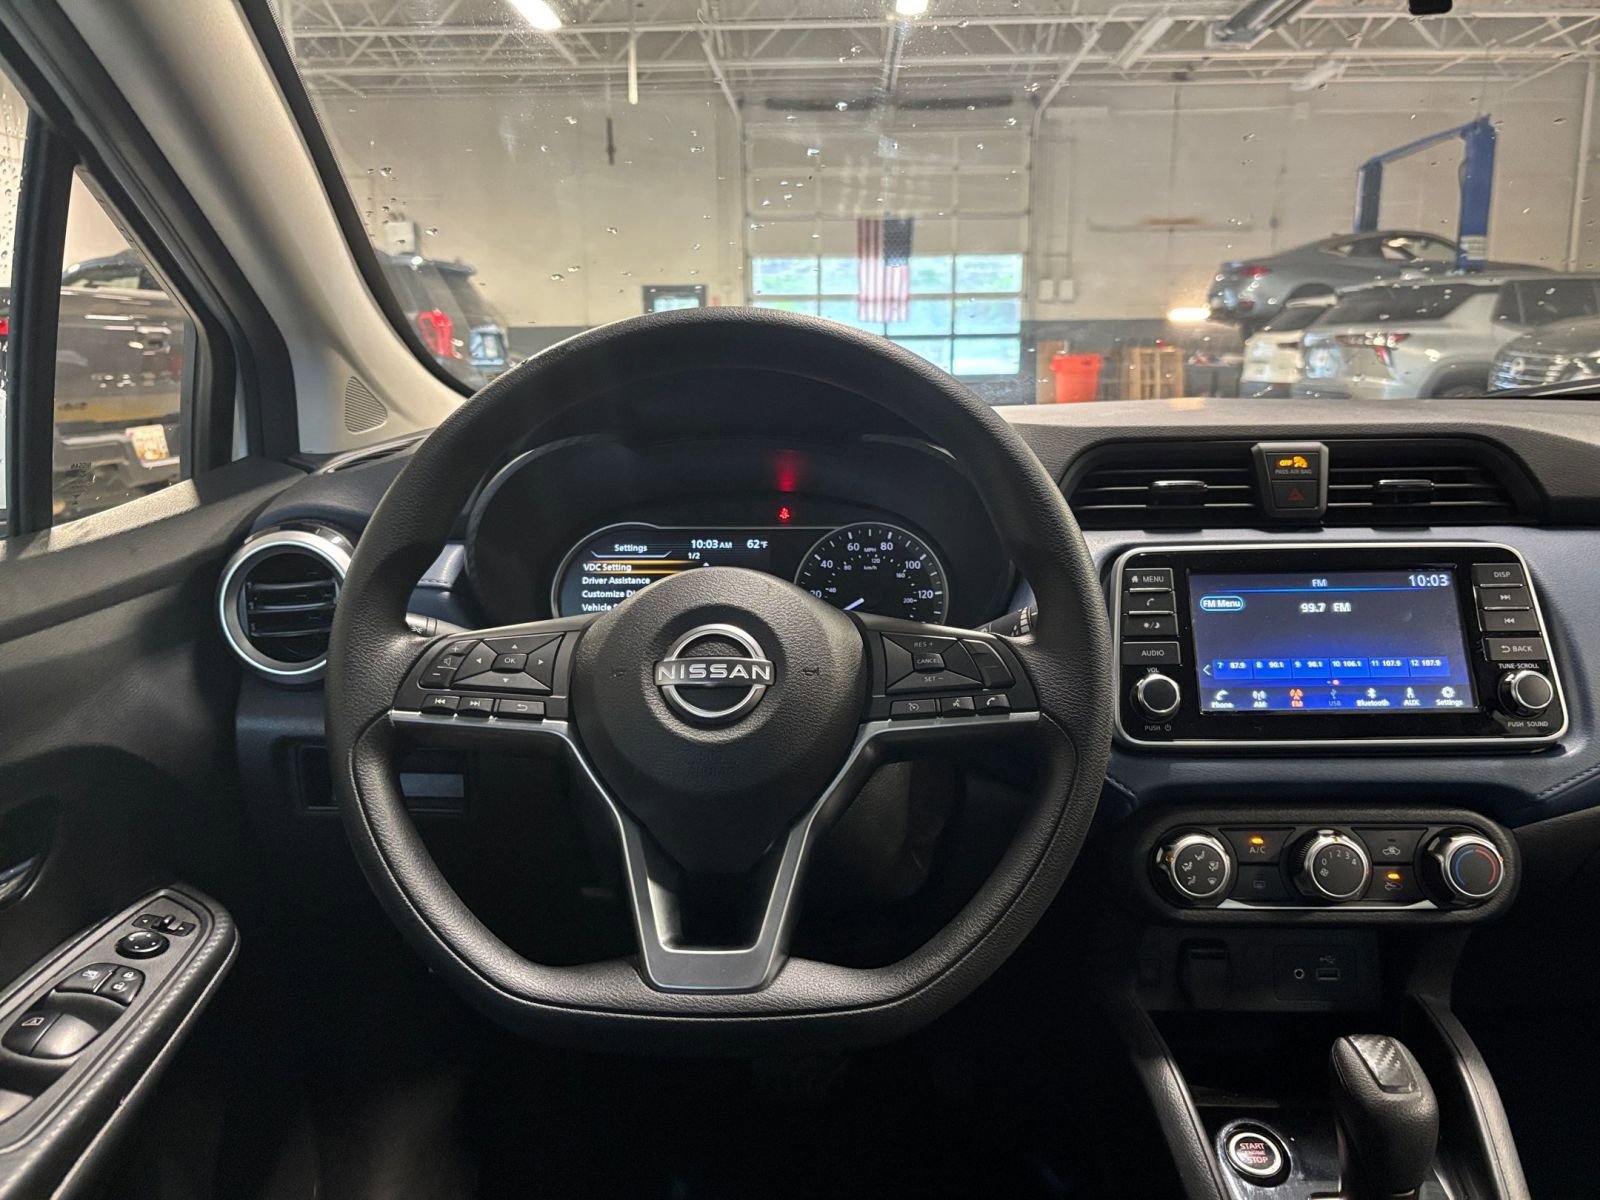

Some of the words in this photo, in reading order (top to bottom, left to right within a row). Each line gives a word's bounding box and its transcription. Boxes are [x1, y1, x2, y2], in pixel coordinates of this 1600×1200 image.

[614, 544, 647, 553] Settings
[691, 540, 718, 549] 10:03
[847, 543, 859, 551] 60
[880, 543, 893, 551] 80
[602, 563, 632, 572] Setting
[820, 560, 833, 568] 40
[905, 561, 920, 569] 100
[582, 577, 607, 585] Driver
[608, 577, 650, 585] Assistance
[1312, 579, 1327, 587] FM
[1409, 575, 1449, 586] 10:03
[582, 590, 625, 598] Customize
[918, 591, 933, 599] 120
[582, 603, 612, 611] Vehicle
[1301, 603, 1326, 612] 99.7
[1333, 603, 1351, 612] FM
[658, 663, 770, 680] NISSAN
[1436, 699, 1464, 707] Settings
[1249, 846, 1265, 854] A/C
[1240, 1142, 1265, 1150] START
[1248, 1156, 1268, 1164] STOP
